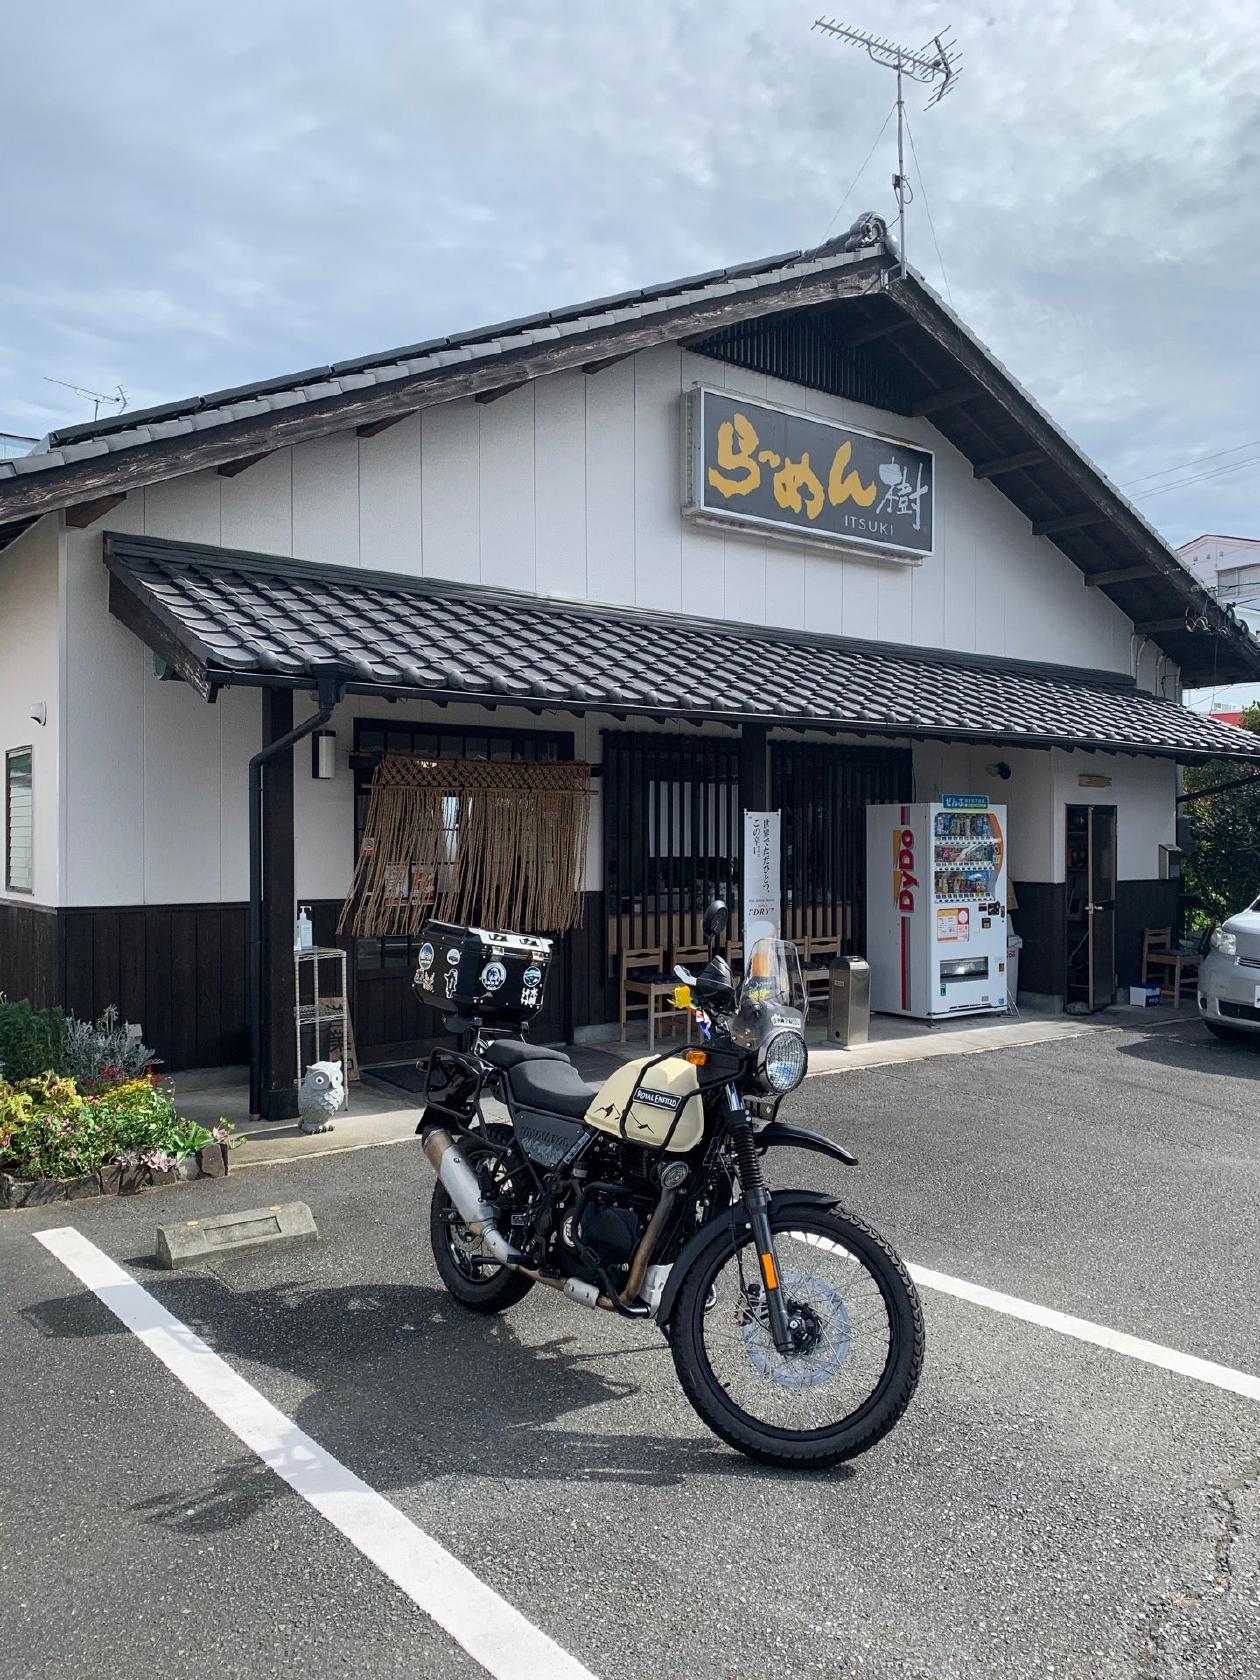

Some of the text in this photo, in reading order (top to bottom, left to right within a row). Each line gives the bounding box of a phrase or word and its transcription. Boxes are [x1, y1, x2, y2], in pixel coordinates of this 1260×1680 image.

[844, 514, 894, 536] ITSUKI
[637, 1090, 677, 1107] ROYAL ENFIELD
